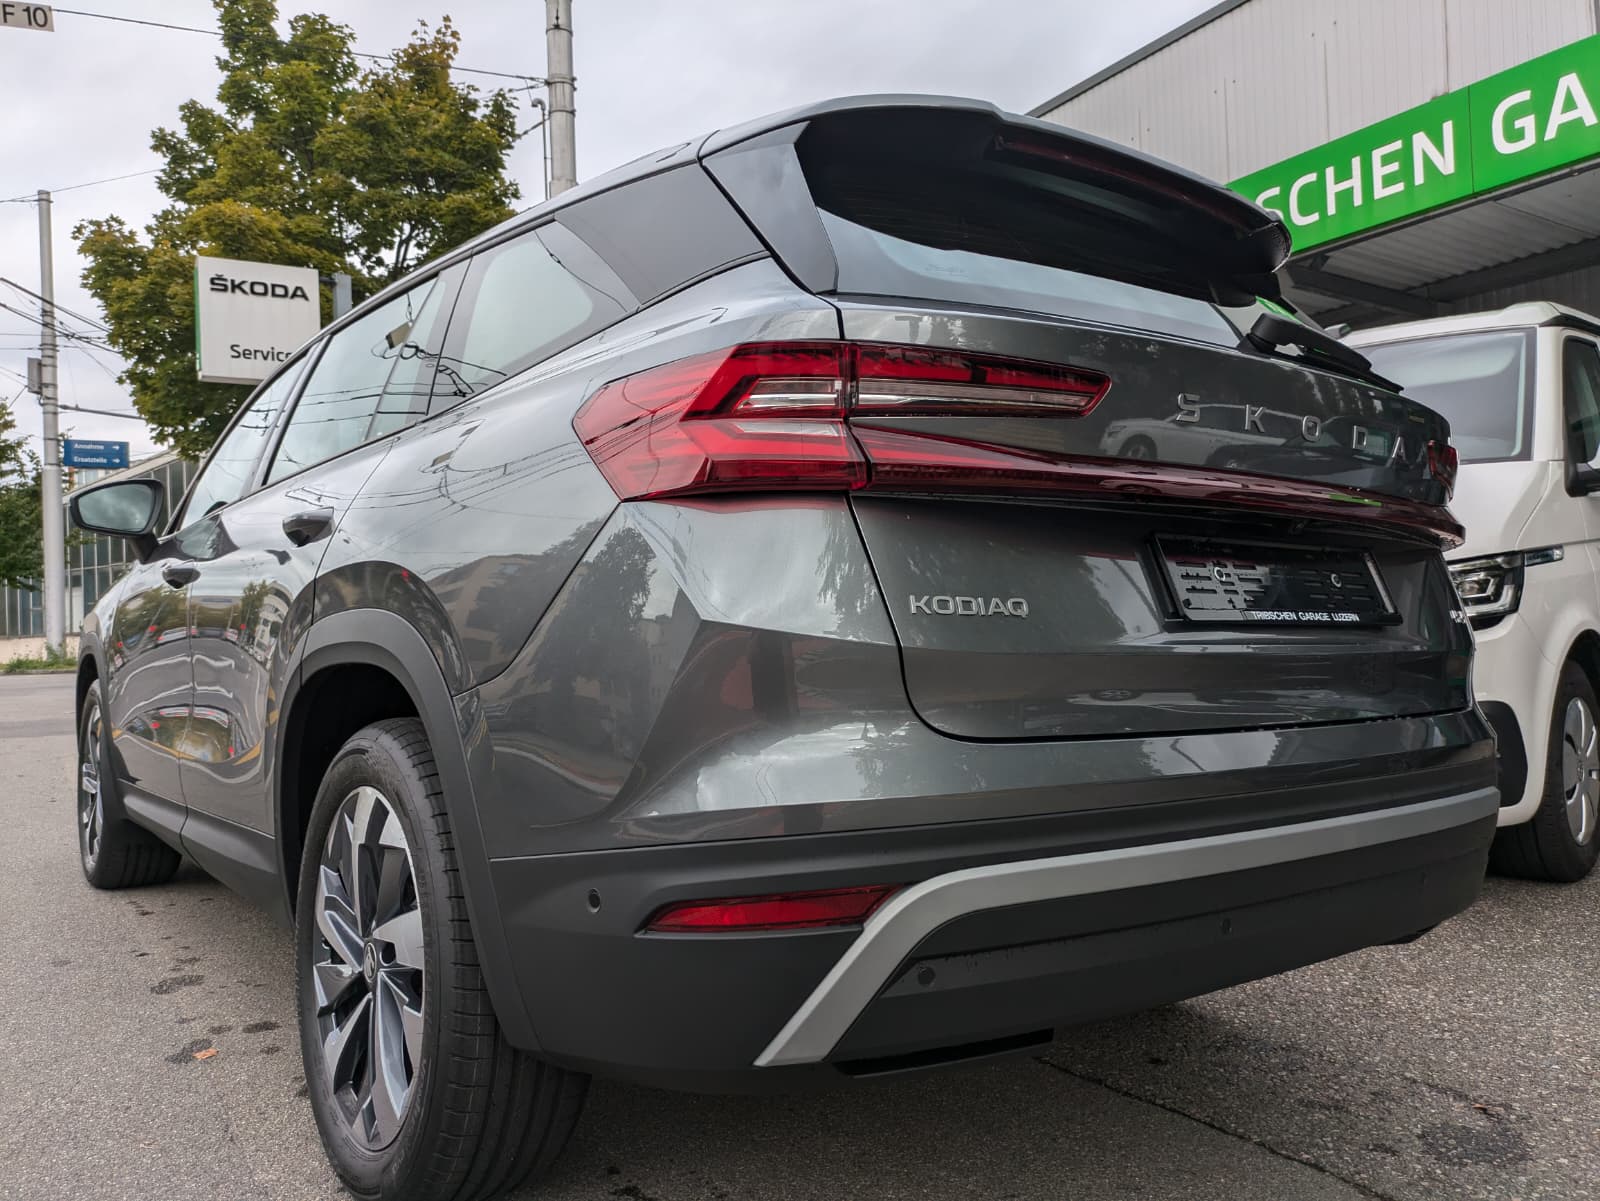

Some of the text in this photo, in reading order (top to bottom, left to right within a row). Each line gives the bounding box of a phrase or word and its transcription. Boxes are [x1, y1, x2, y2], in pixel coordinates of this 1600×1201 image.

[2, 3, 48, 28] F 10
[1491, 72, 1599, 155] GA
[209, 273, 310, 302] ŠKODA
[73, 456, 107, 464] Ersatzteile
[909, 594, 1029, 618] KODIAQ
[1251, 610, 1360, 622] TRIBSCHEN GARAGE LUZERN
